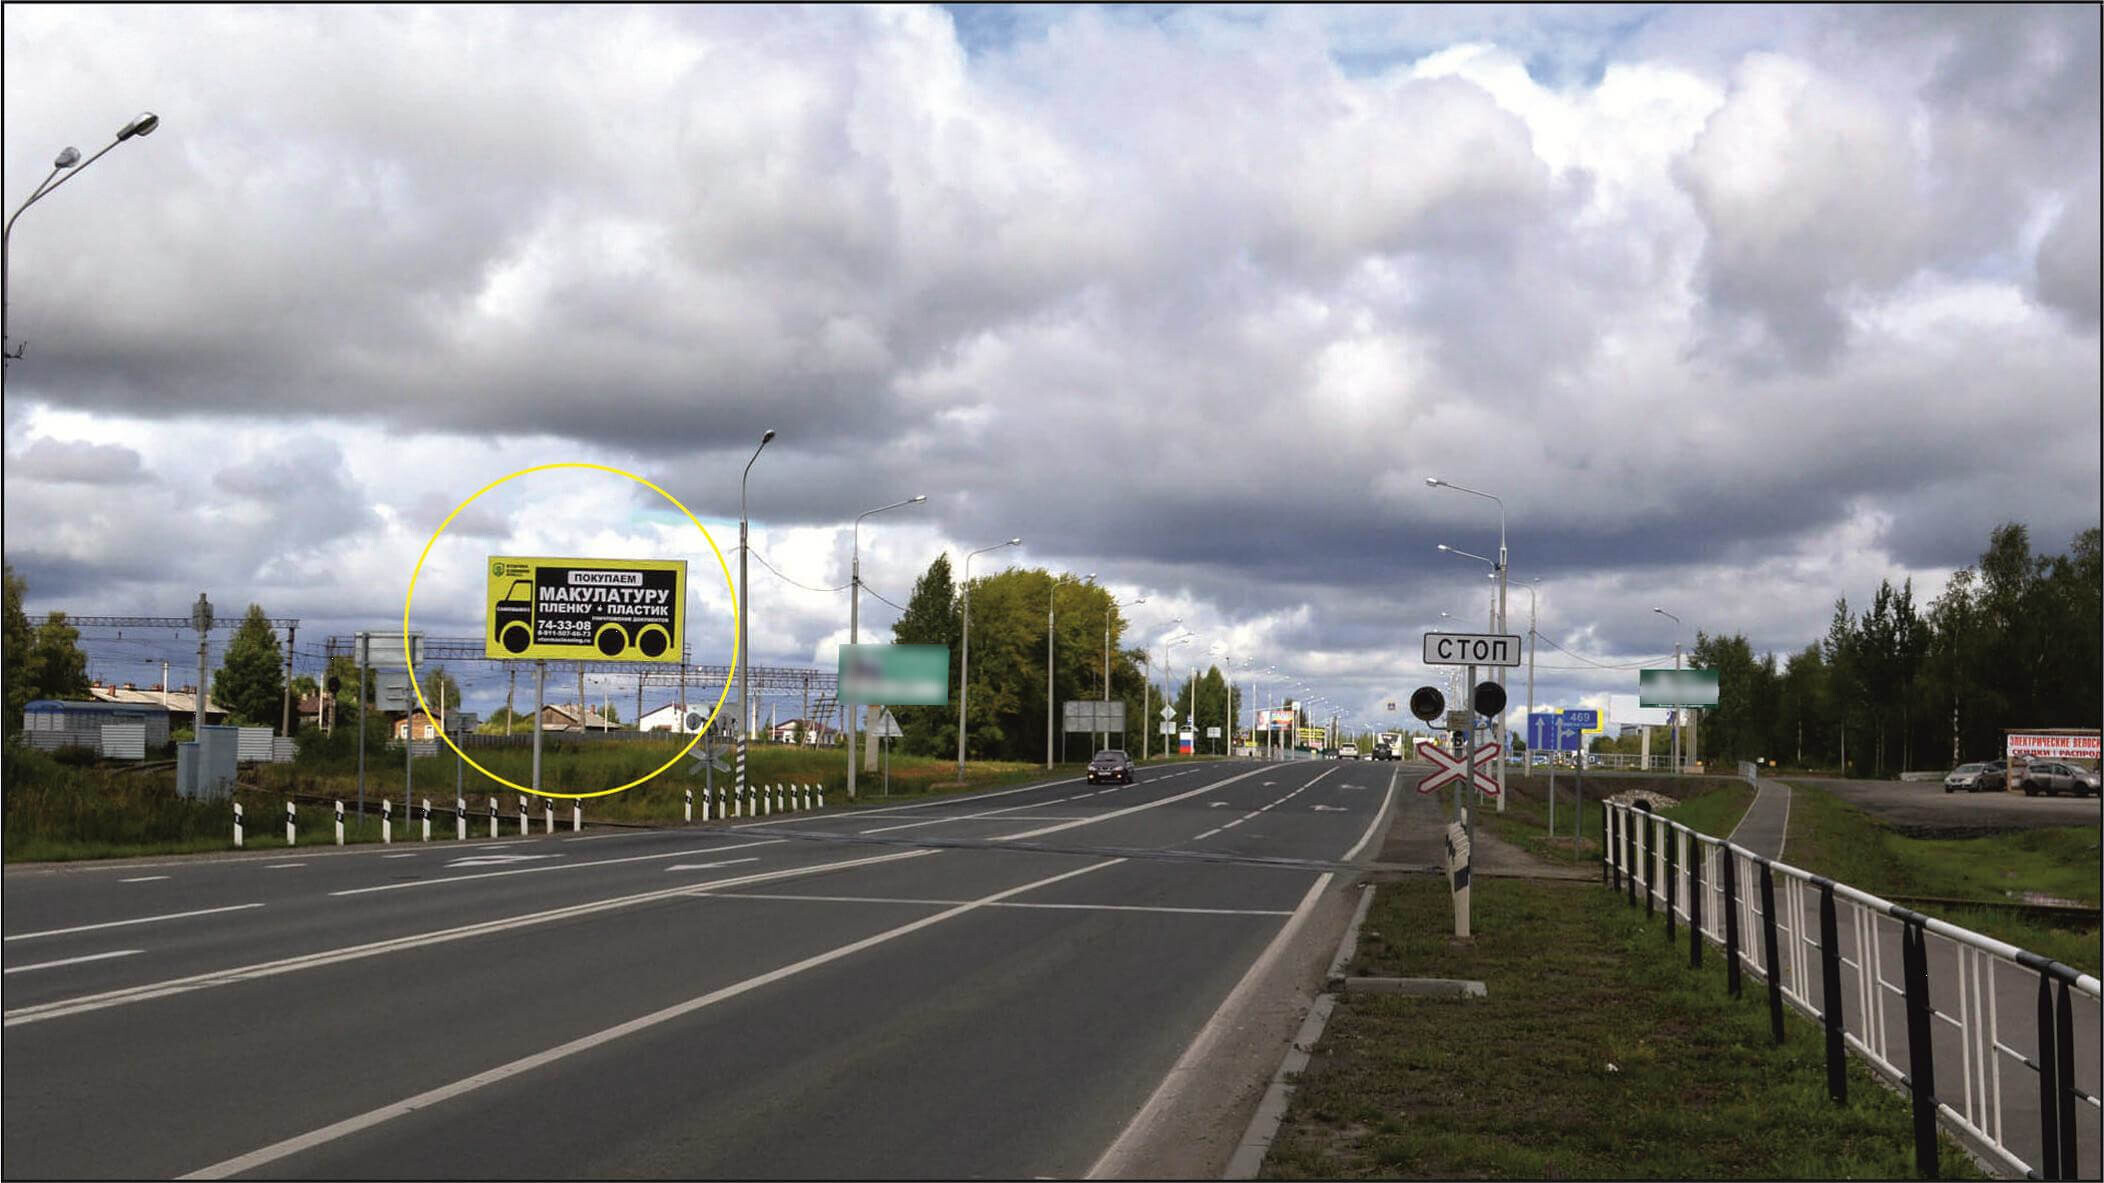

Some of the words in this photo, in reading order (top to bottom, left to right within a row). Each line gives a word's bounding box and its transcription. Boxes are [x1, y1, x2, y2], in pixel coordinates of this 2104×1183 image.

[574, 573, 637, 584] ПОКУПАЕМ
[539, 586, 670, 604] МАКУЛАТУРУ
[539, 602, 592, 614] ПЛЕНКУ
[607, 604, 669, 616] ПЛАСТИК
[537, 620, 591, 631] 74-33-08
[1438, 638, 1508, 661] СТОП
[1569, 711, 1590, 722] 469
[2010, 736, 2069, 747] ЭЛЕКТРИЧЕСКИЕ
